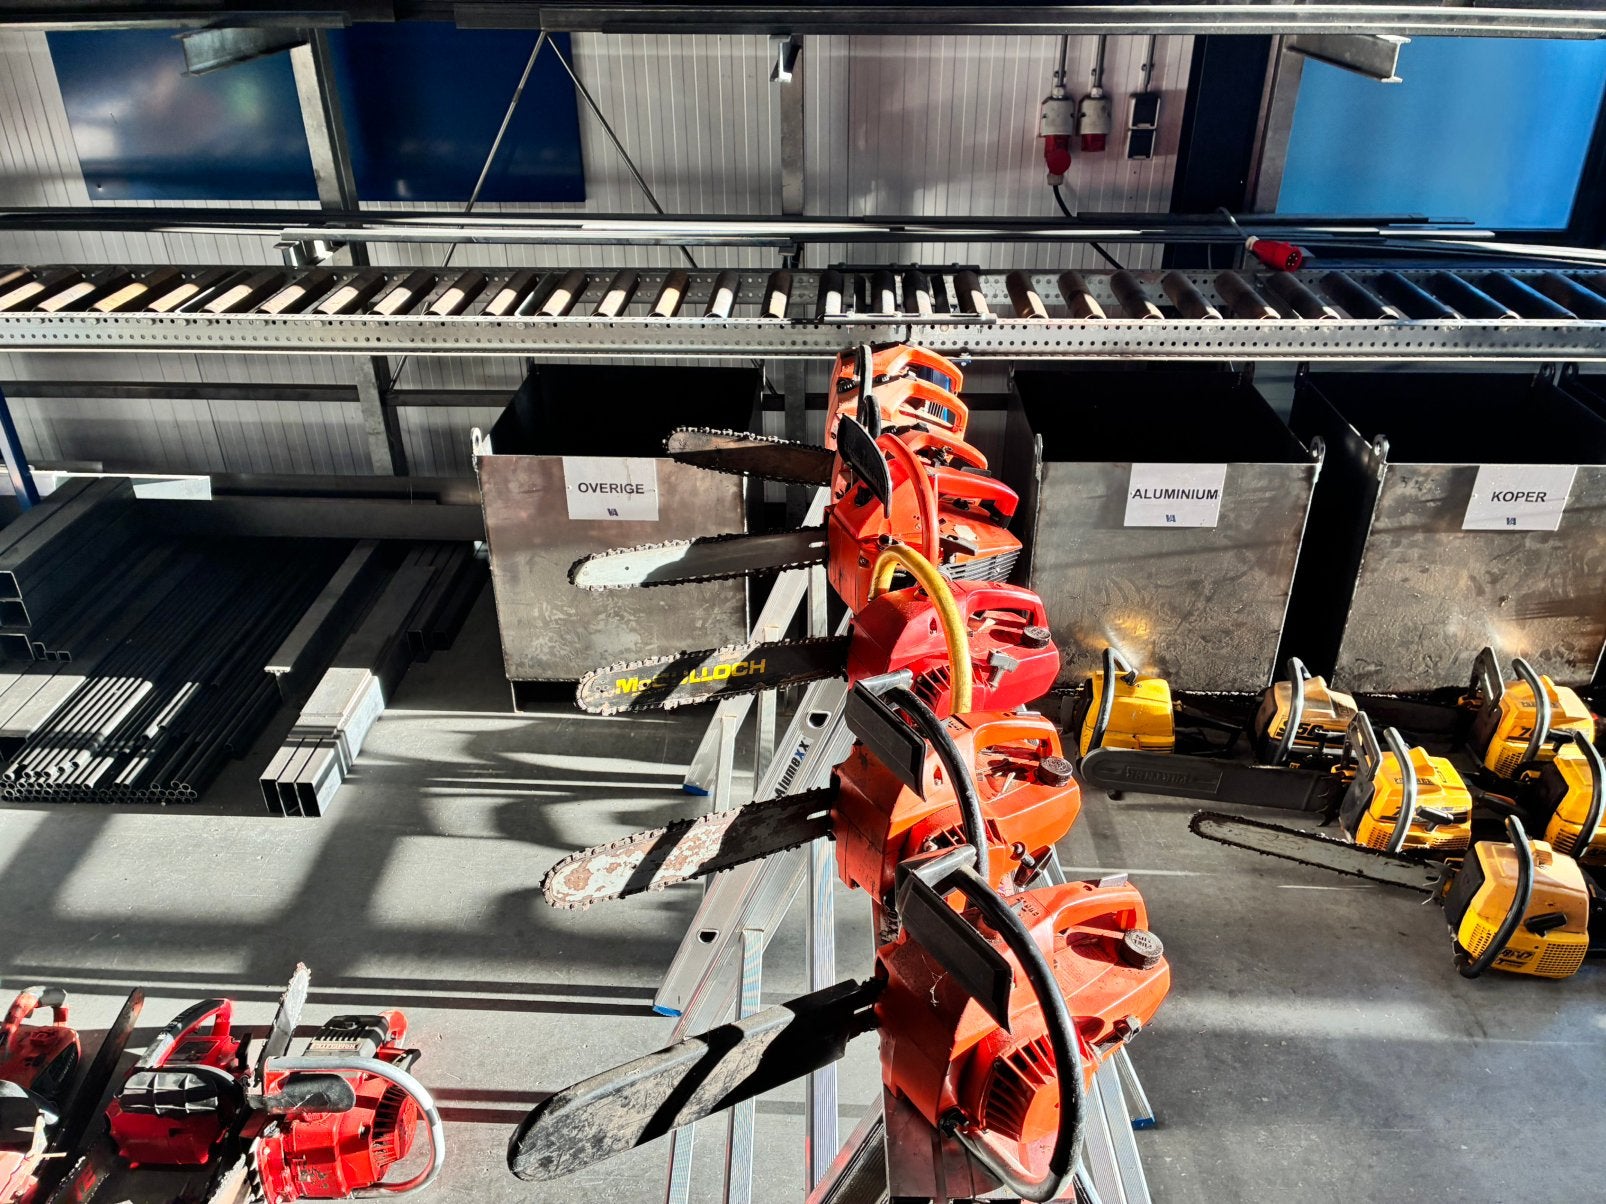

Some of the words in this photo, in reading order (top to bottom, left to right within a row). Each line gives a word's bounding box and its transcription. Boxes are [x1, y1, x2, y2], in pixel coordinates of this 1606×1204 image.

[578, 482, 645, 495] OVERIGE
[1132, 488, 1219, 500] ALUMINIUM
[1490, 491, 1547, 502] KOPER
[615, 659, 767, 695] McCLLOCH
[774, 740, 810, 799] Alumexx
